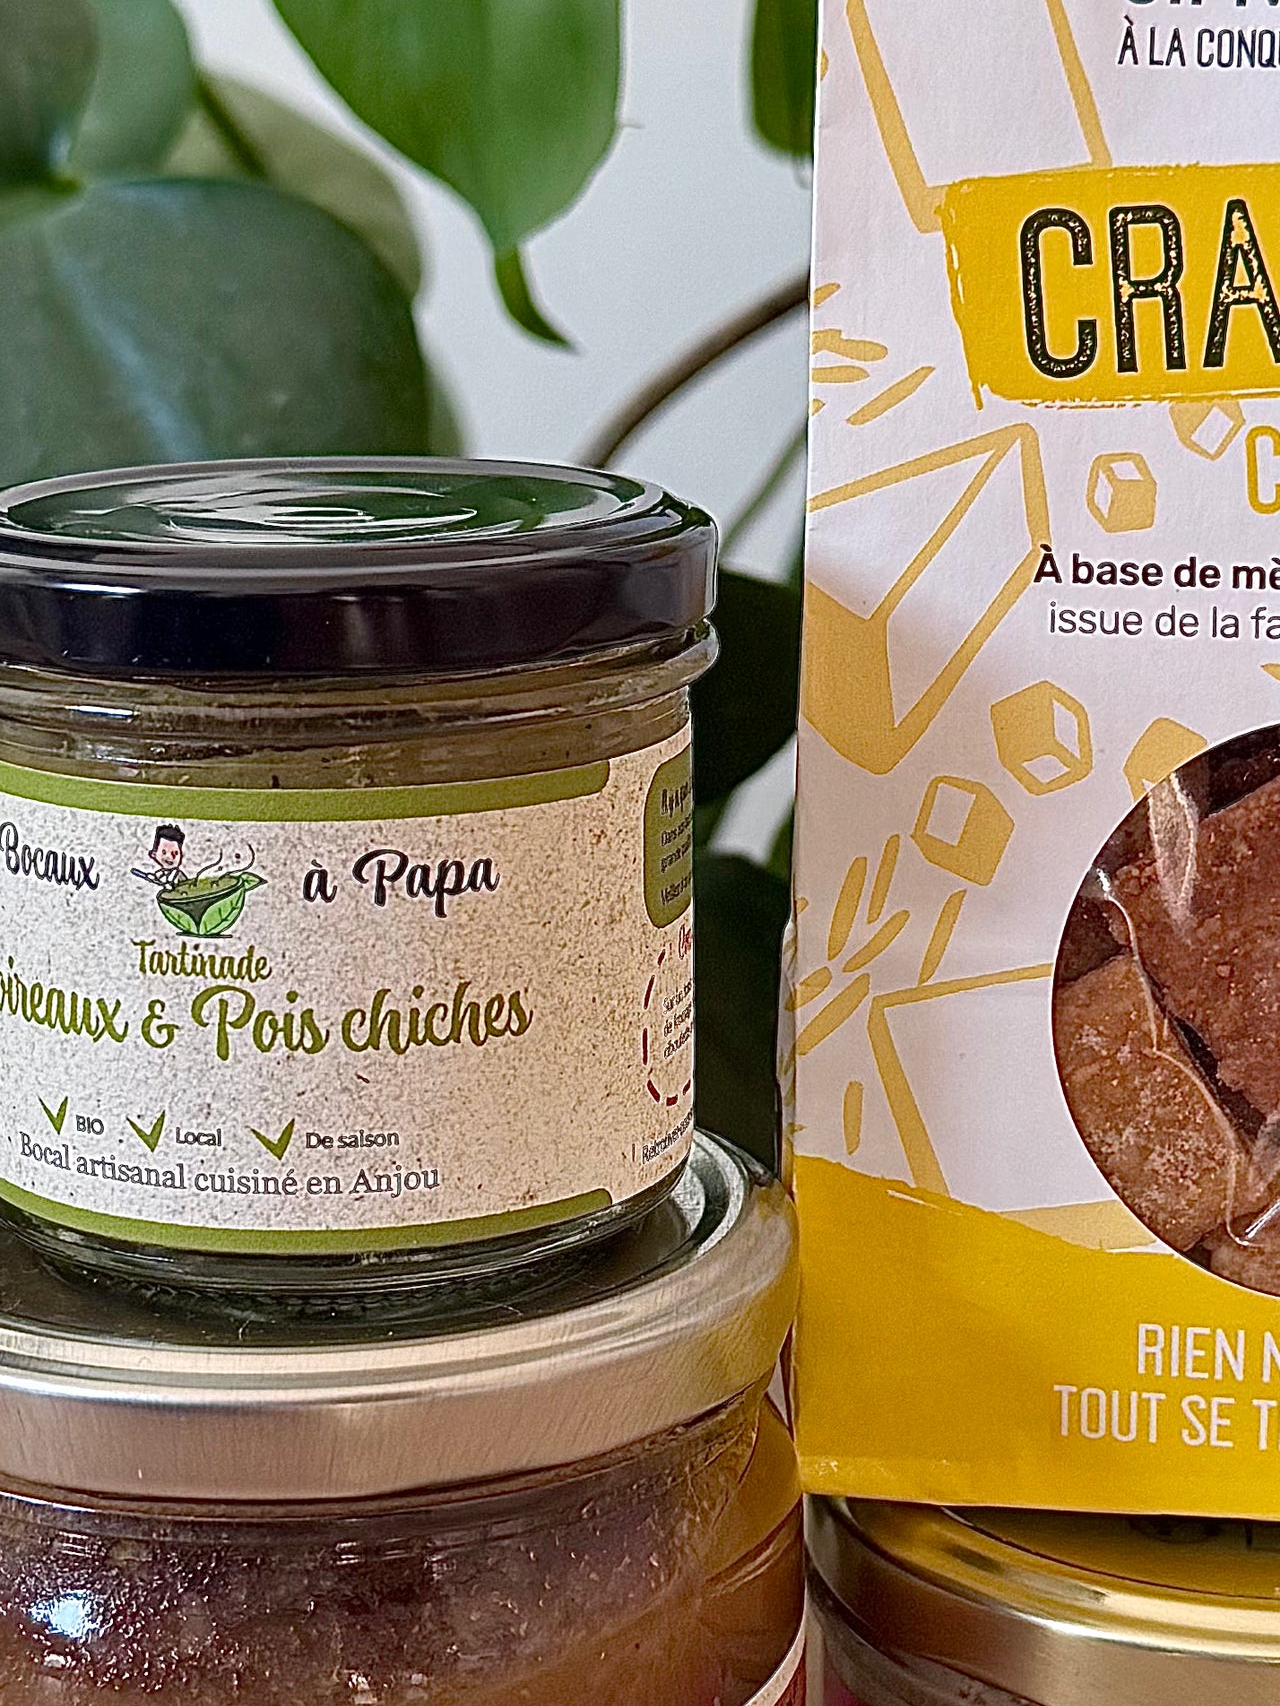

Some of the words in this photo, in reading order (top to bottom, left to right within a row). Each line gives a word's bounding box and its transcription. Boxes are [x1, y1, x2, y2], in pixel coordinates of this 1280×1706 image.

[1119, 15, 1138, 65] À
[1148, 27, 1186, 66] LA
[1032, 545, 1061, 584] À
[1072, 554, 1162, 588] base
[1173, 556, 1220, 590] de
[1049, 602, 1142, 637] issue
[1154, 605, 1198, 637] de
[1212, 606, 1240, 639] la
[303, 858, 337, 903] à
[352, 849, 500, 916] Papa
[131, 939, 272, 982] Tartinade
[141, 999, 179, 1049] &
[192, 984, 330, 1061] Pois
[342, 981, 534, 1055] chiches
[75, 1114, 105, 1134] BIO
[175, 1128, 222, 1147] Local
[305, 1132, 334, 1149] De
[337, 1129, 400, 1148] saison
[20, 1131, 70, 1171] Bocal
[77, 1153, 186, 1190] artisanal
[194, 1166, 299, 1195] cuisiné
[305, 1176, 343, 1195] en
[348, 1166, 440, 1198] Anjou
[1137, 1323, 1245, 1383] RIEN
[1052, 1384, 1166, 1444] TOUT
[1181, 1395, 1234, 1449] SE
